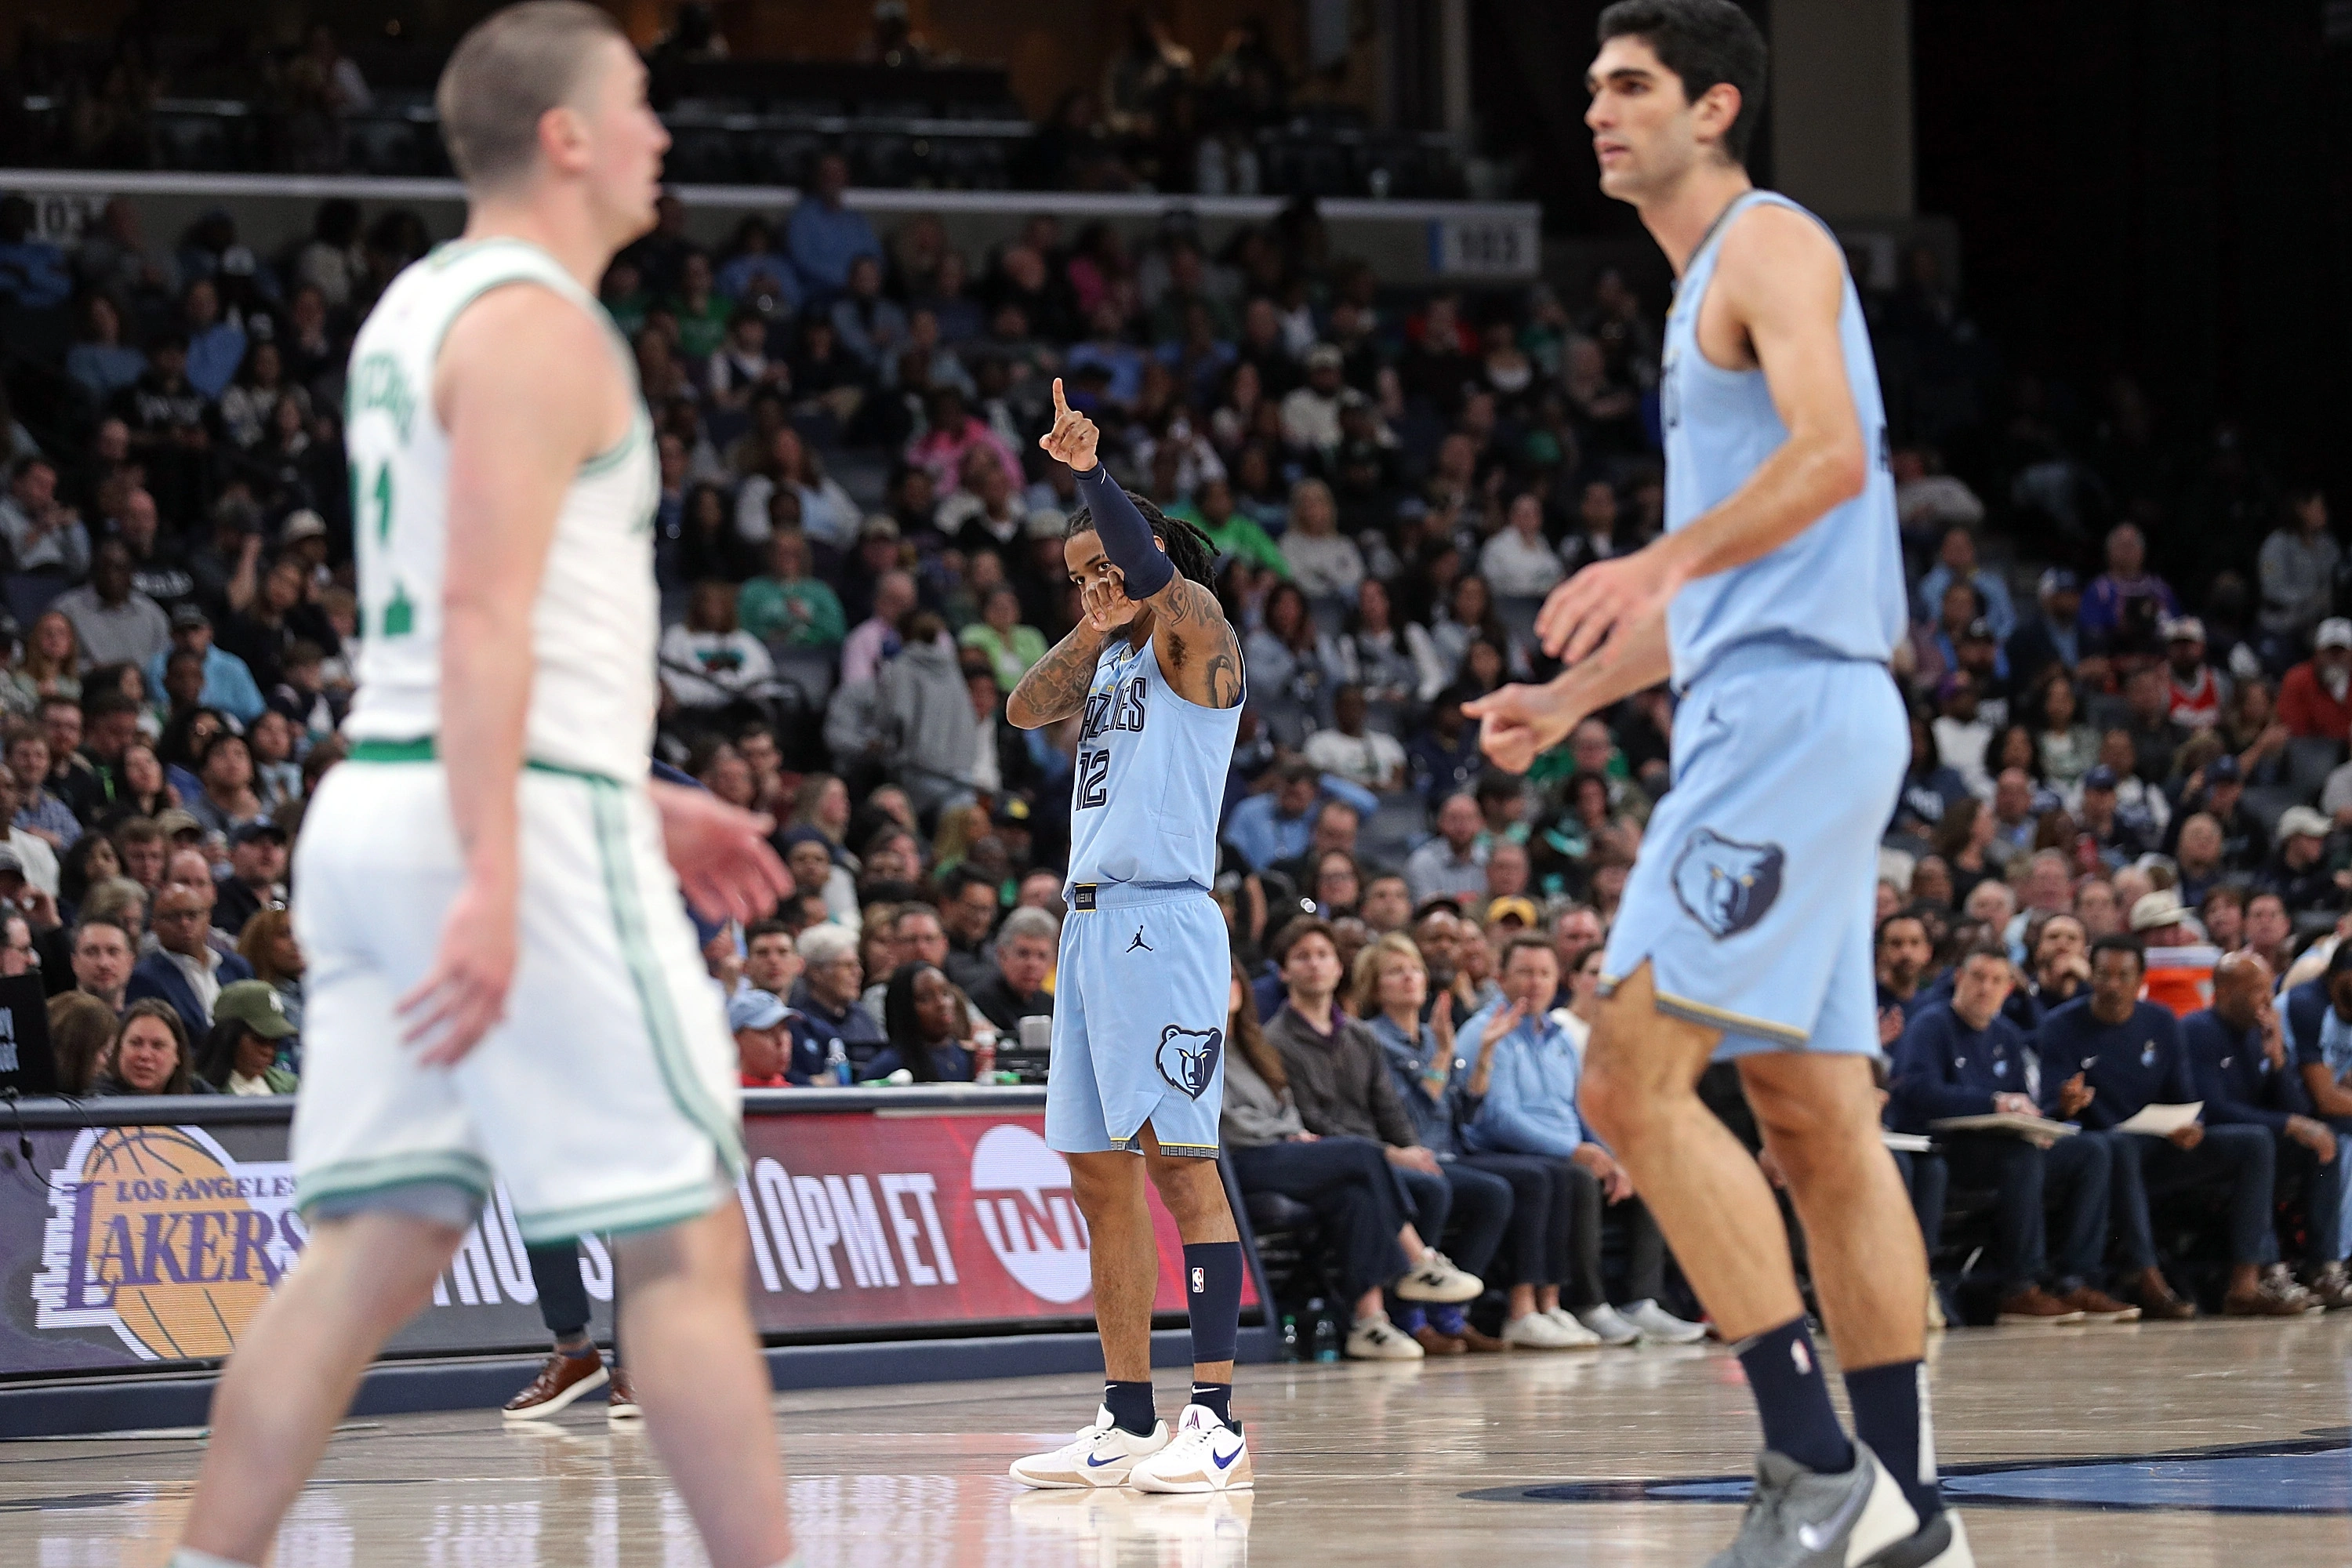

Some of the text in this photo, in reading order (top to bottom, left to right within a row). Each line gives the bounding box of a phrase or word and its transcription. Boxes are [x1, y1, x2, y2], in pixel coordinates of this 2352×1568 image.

[1076, 749, 1110, 811] 12
[116, 1175, 296, 1202] LOS ANGELE
[878, 1172, 959, 1287] ET
